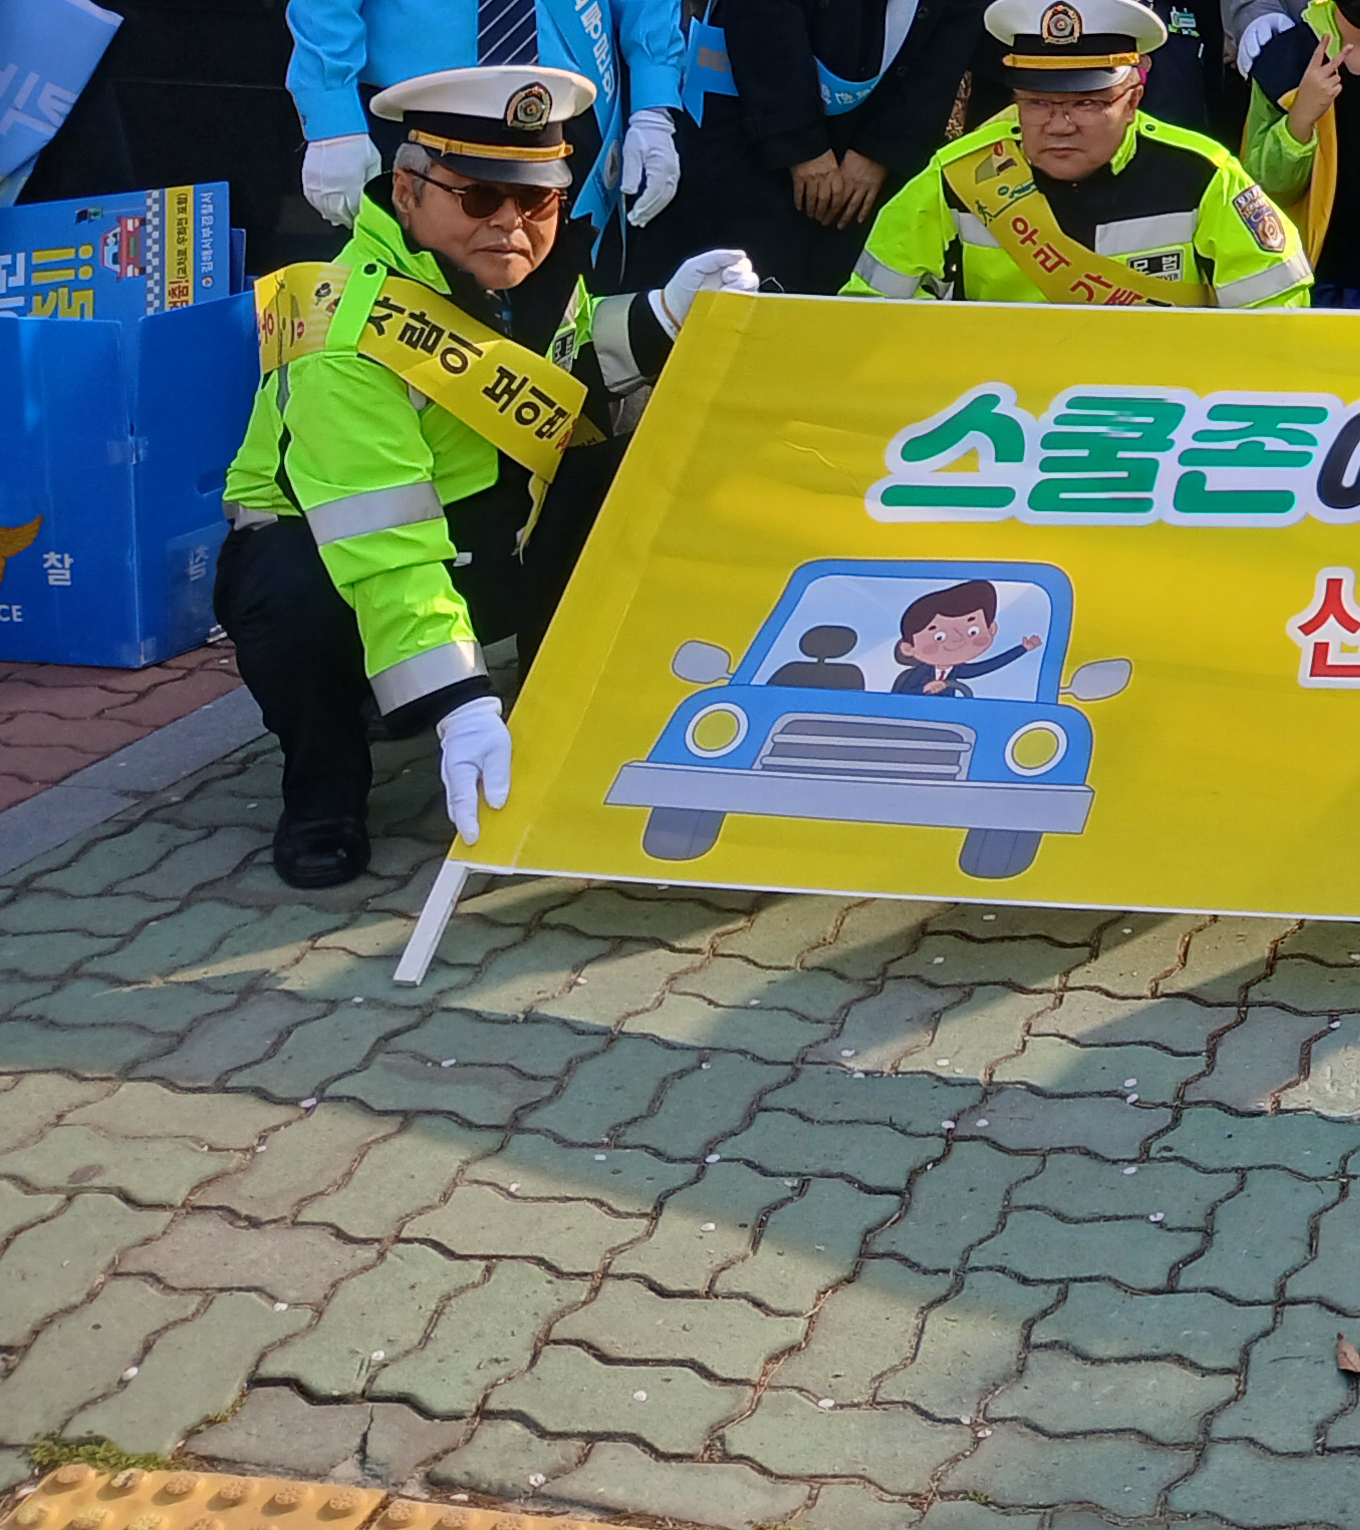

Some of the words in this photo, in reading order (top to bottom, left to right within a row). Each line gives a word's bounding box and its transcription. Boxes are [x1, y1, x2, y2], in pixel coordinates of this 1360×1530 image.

[199, 191, 215, 273] 김해서부경찰서
[1011, 216, 1072, 274] 우리
[368, 296, 485, 377] 사람이
[481, 364, 574, 441] 보이면
[42, 551, 75, 587] 찰
